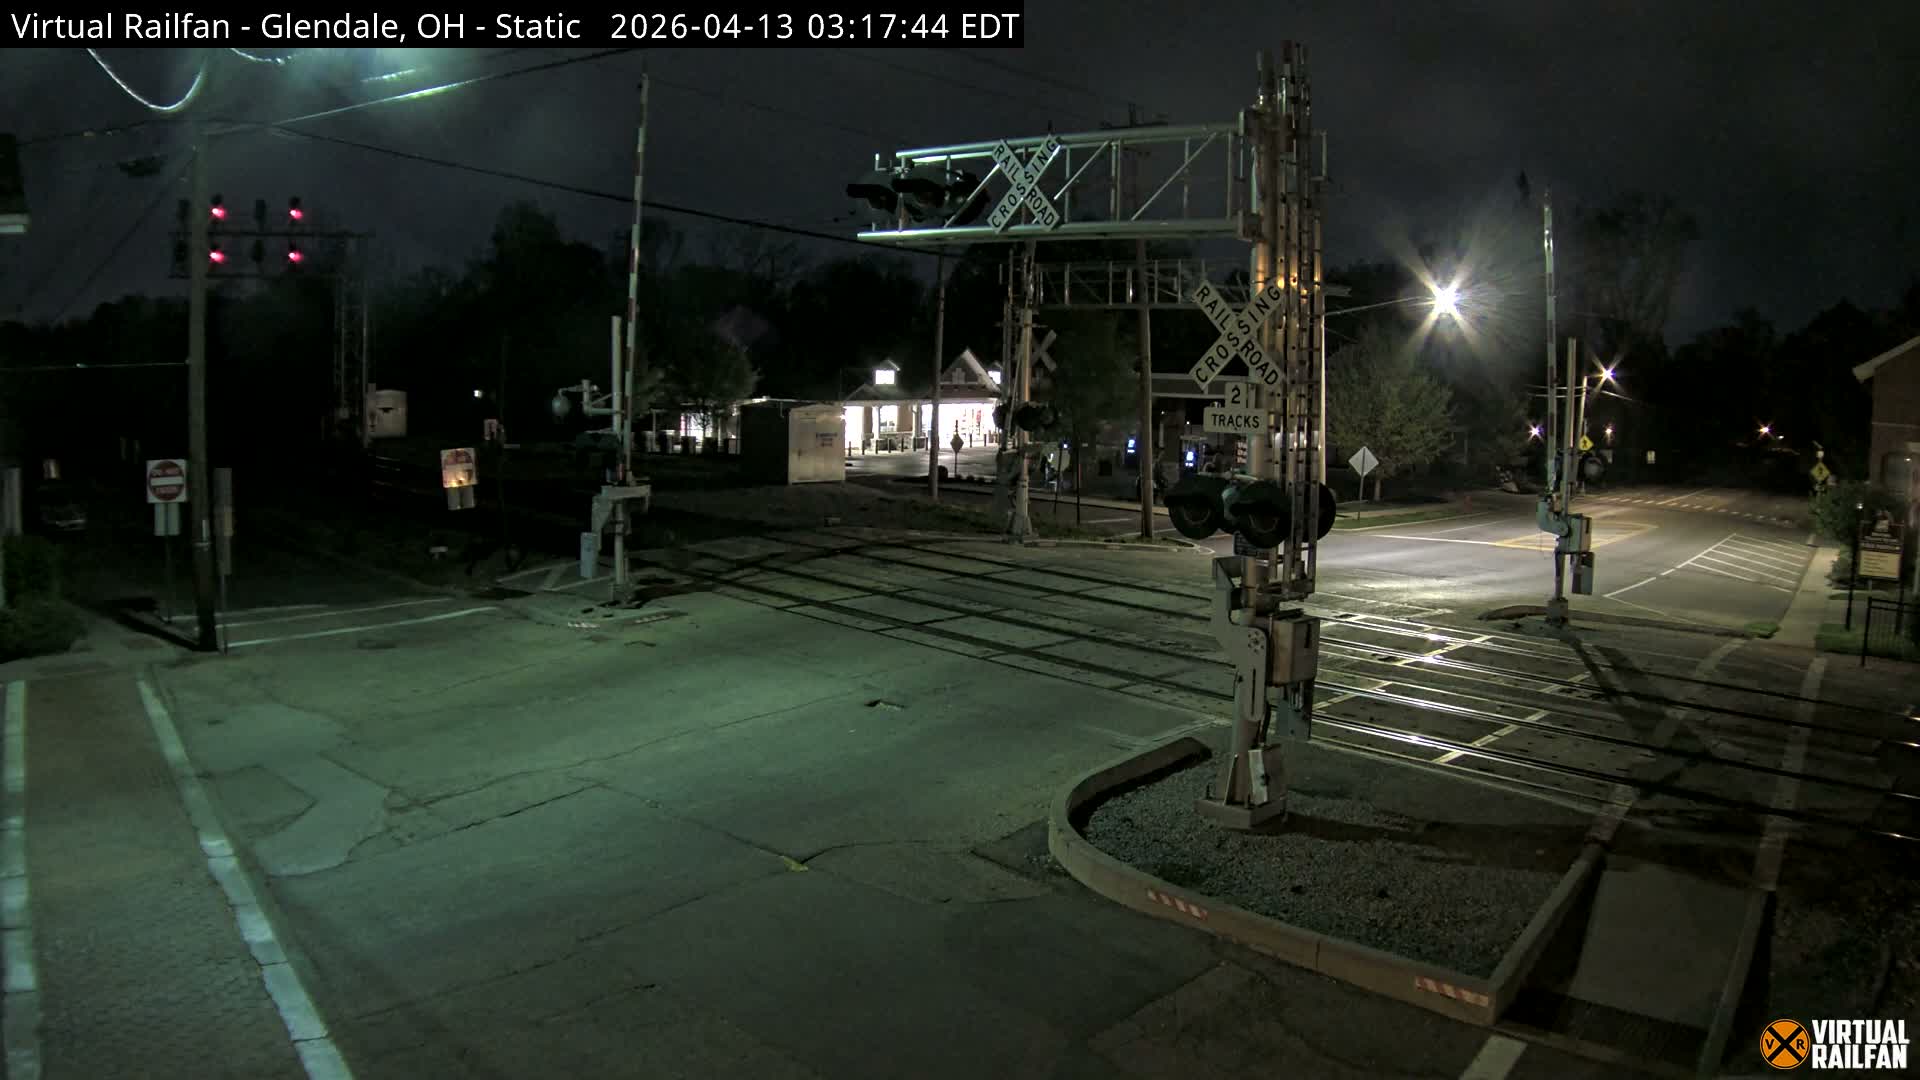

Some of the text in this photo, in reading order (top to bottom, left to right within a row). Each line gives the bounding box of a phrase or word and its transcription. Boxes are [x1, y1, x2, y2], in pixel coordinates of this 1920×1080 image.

[992, 140, 1055, 228] CROSSING
[1195, 286, 1280, 383] CROSSING
[1212, 414, 1260, 429] TRACKS
[1231, 387, 1241, 404] 2
